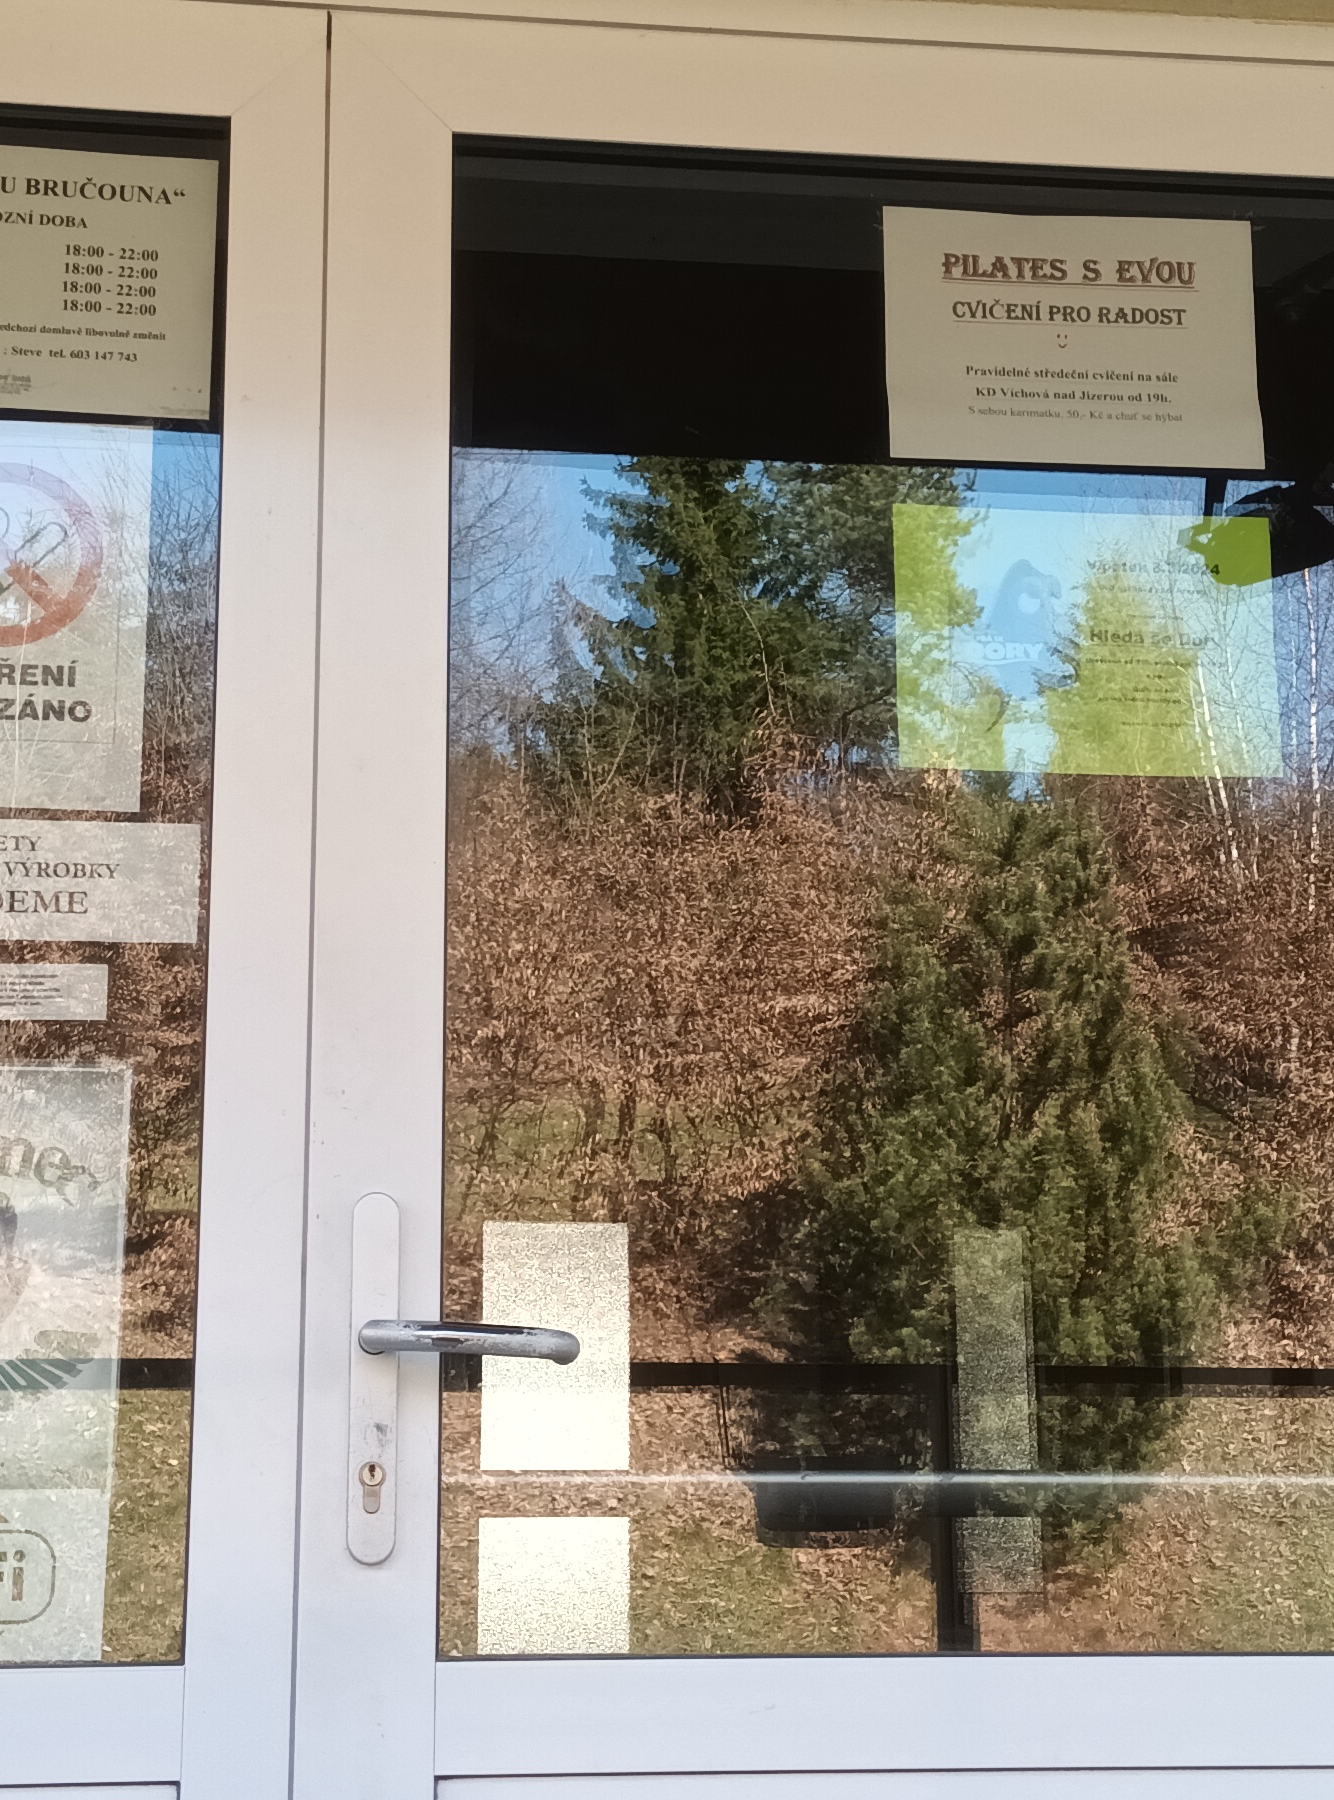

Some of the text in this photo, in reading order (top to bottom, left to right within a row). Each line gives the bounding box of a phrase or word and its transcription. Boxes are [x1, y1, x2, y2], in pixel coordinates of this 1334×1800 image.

[25, 177, 186, 205] BRUČOUNA“
[39, 213, 88, 229] DOBA
[65, 244, 105, 258] 18:00
[119, 247, 159, 262] 22:00
[64, 262, 104, 276] 18:00
[118, 265, 158, 280] 22:00
[942, 252, 1196, 286] PILATES S EVOU
[62, 280, 102, 295] 18:00
[116, 284, 156, 298] 22:00
[62, 299, 102, 313] 18:00
[116, 302, 157, 317] 22:00
[952, 298, 1187, 326] CVIČENÍ PRO RADOST
[132, 331, 167, 341] změnit
[11, 345, 42, 357] Steve
[69, 349, 91, 360] 603
[94, 351, 114, 361] 147
[118, 352, 138, 363] 743
[966, 365, 1179, 383] Pravidelné středeční cvičení na sále
[975, 386, 997, 397] KD
[1053, 390, 1076, 400] nad
[1079, 390, 1124, 402] Jizerou
[1127, 393, 1143, 402] od
[1107, 412, 1113, 420] a
[1141, 413, 1153, 421] se
[3, 857, 121, 880] VÝROBKY
